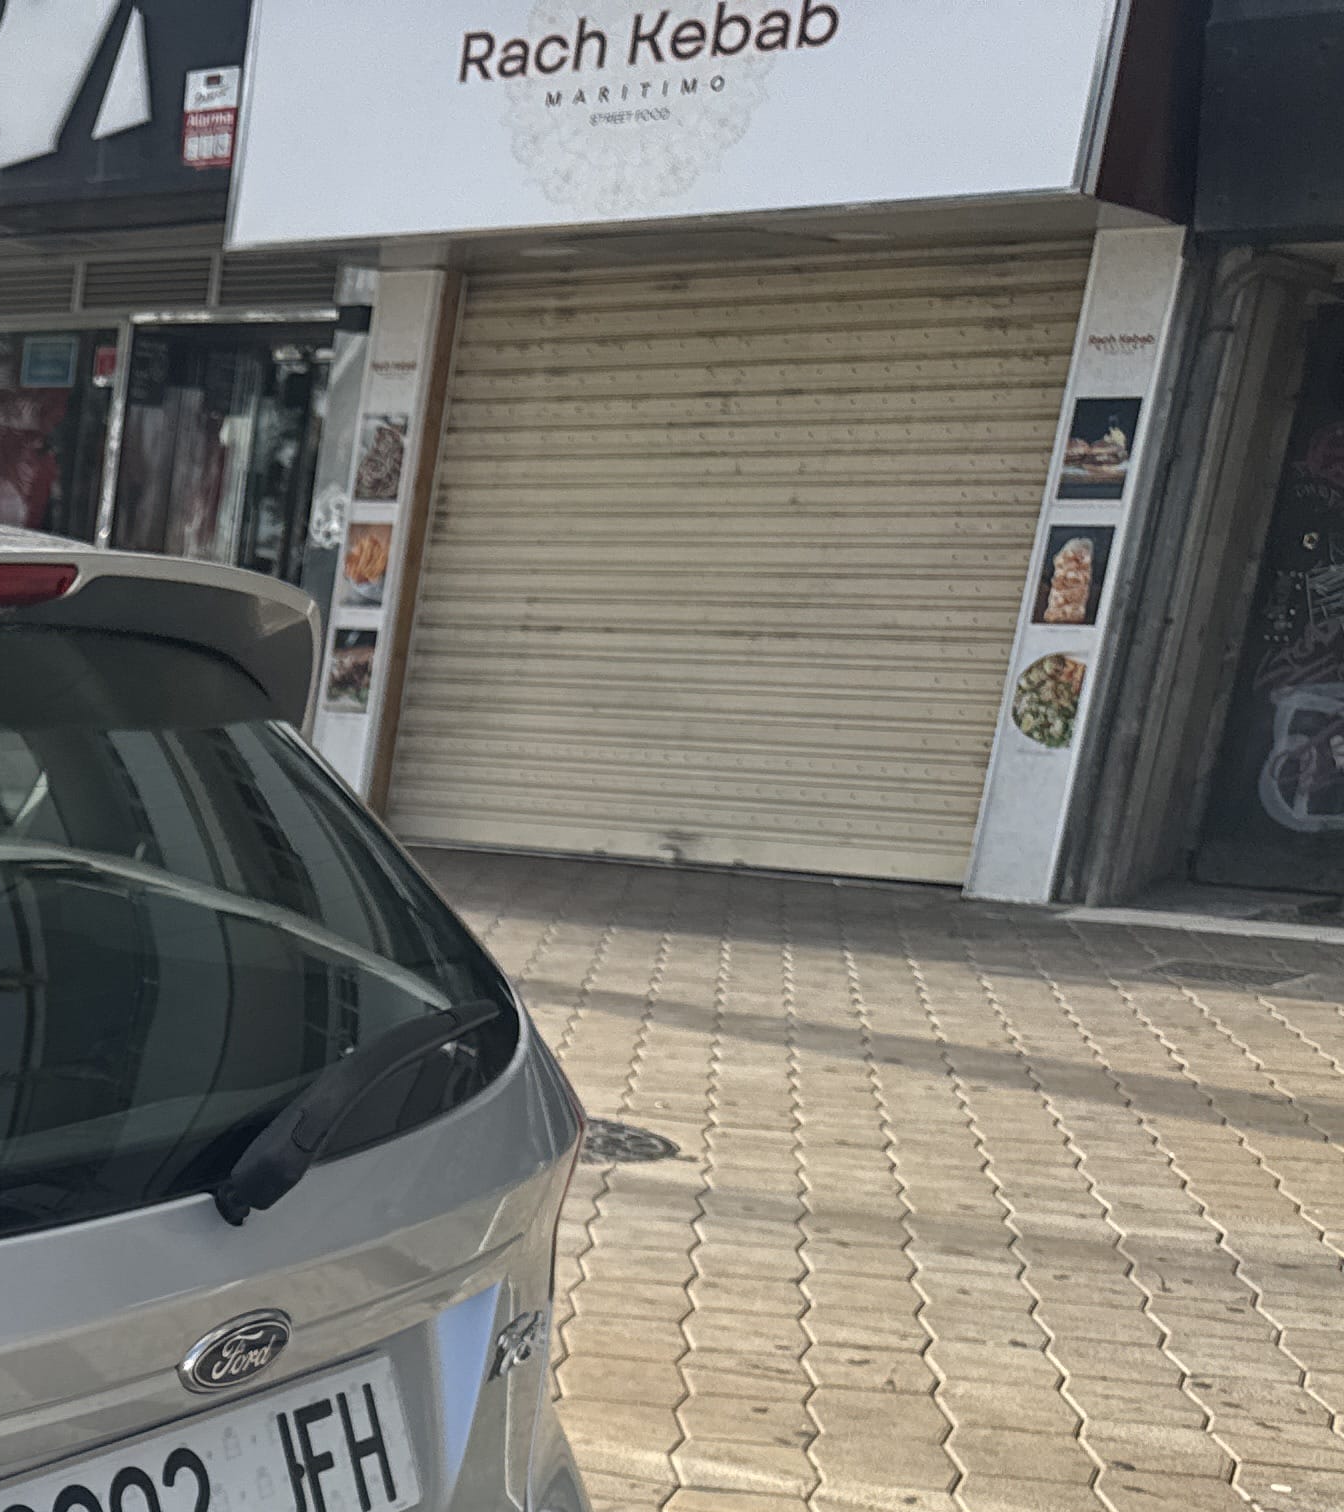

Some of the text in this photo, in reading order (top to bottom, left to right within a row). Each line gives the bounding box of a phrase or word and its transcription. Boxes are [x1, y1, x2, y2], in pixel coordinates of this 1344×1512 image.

[458, 0, 839, 82] Rach Kebab
[544, 75, 726, 108] MARITIMO
[211, 1329, 277, 1381] Ford
